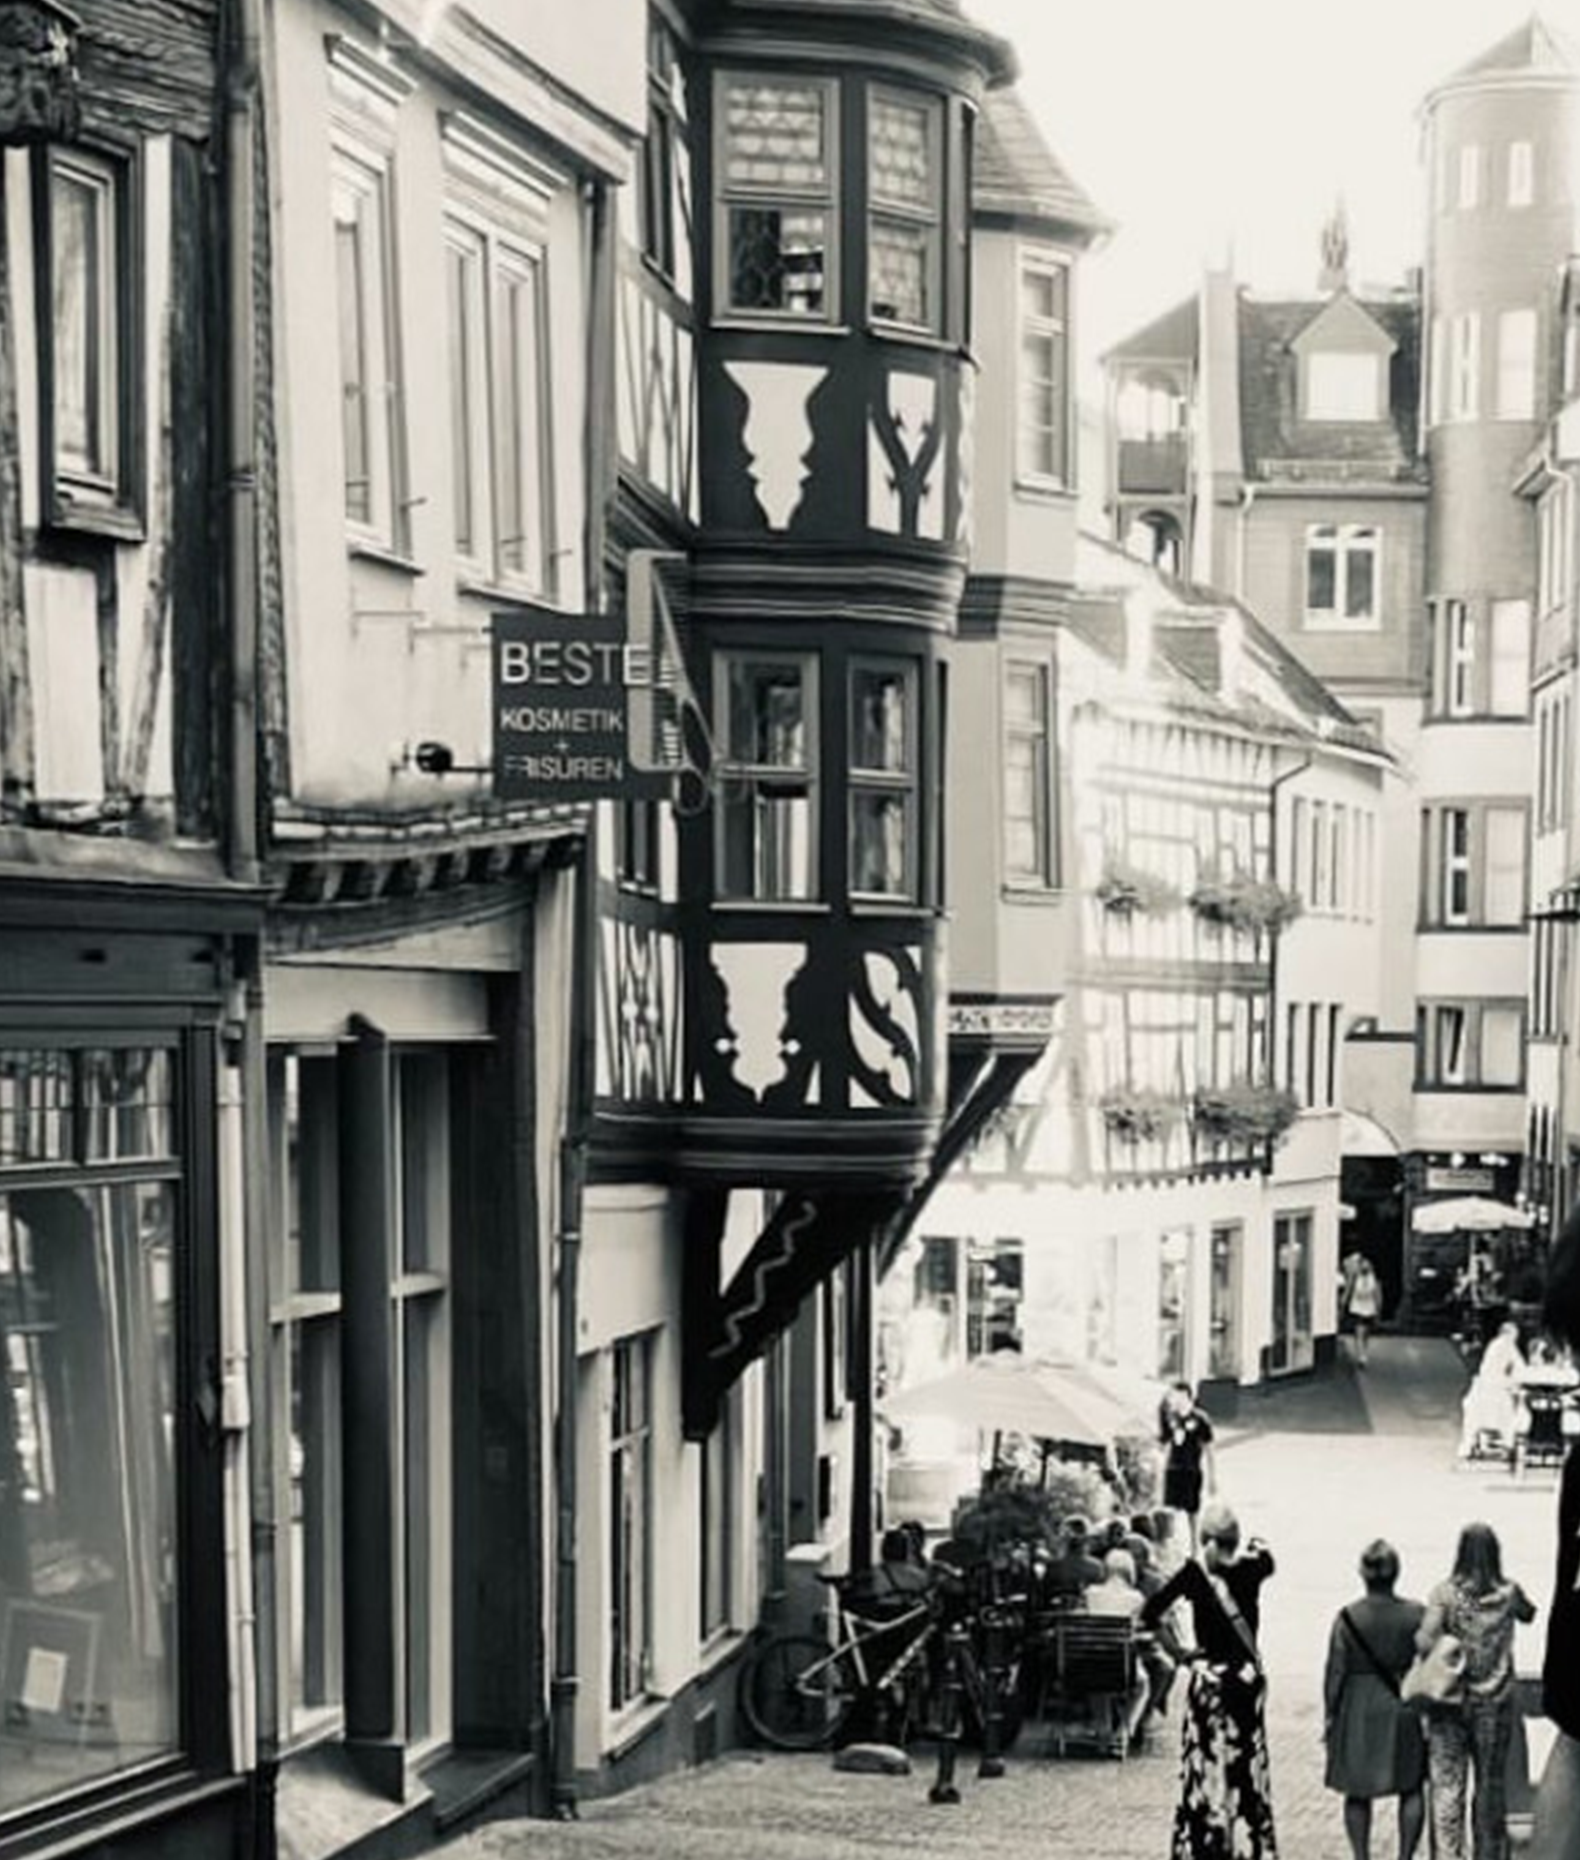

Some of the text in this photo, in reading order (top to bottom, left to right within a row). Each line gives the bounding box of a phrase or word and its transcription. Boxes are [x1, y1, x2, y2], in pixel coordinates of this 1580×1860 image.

[501, 641, 651, 686] BESTE
[501, 706, 623, 733] KOSMETIK
[503, 755, 624, 782] FRISUREN
